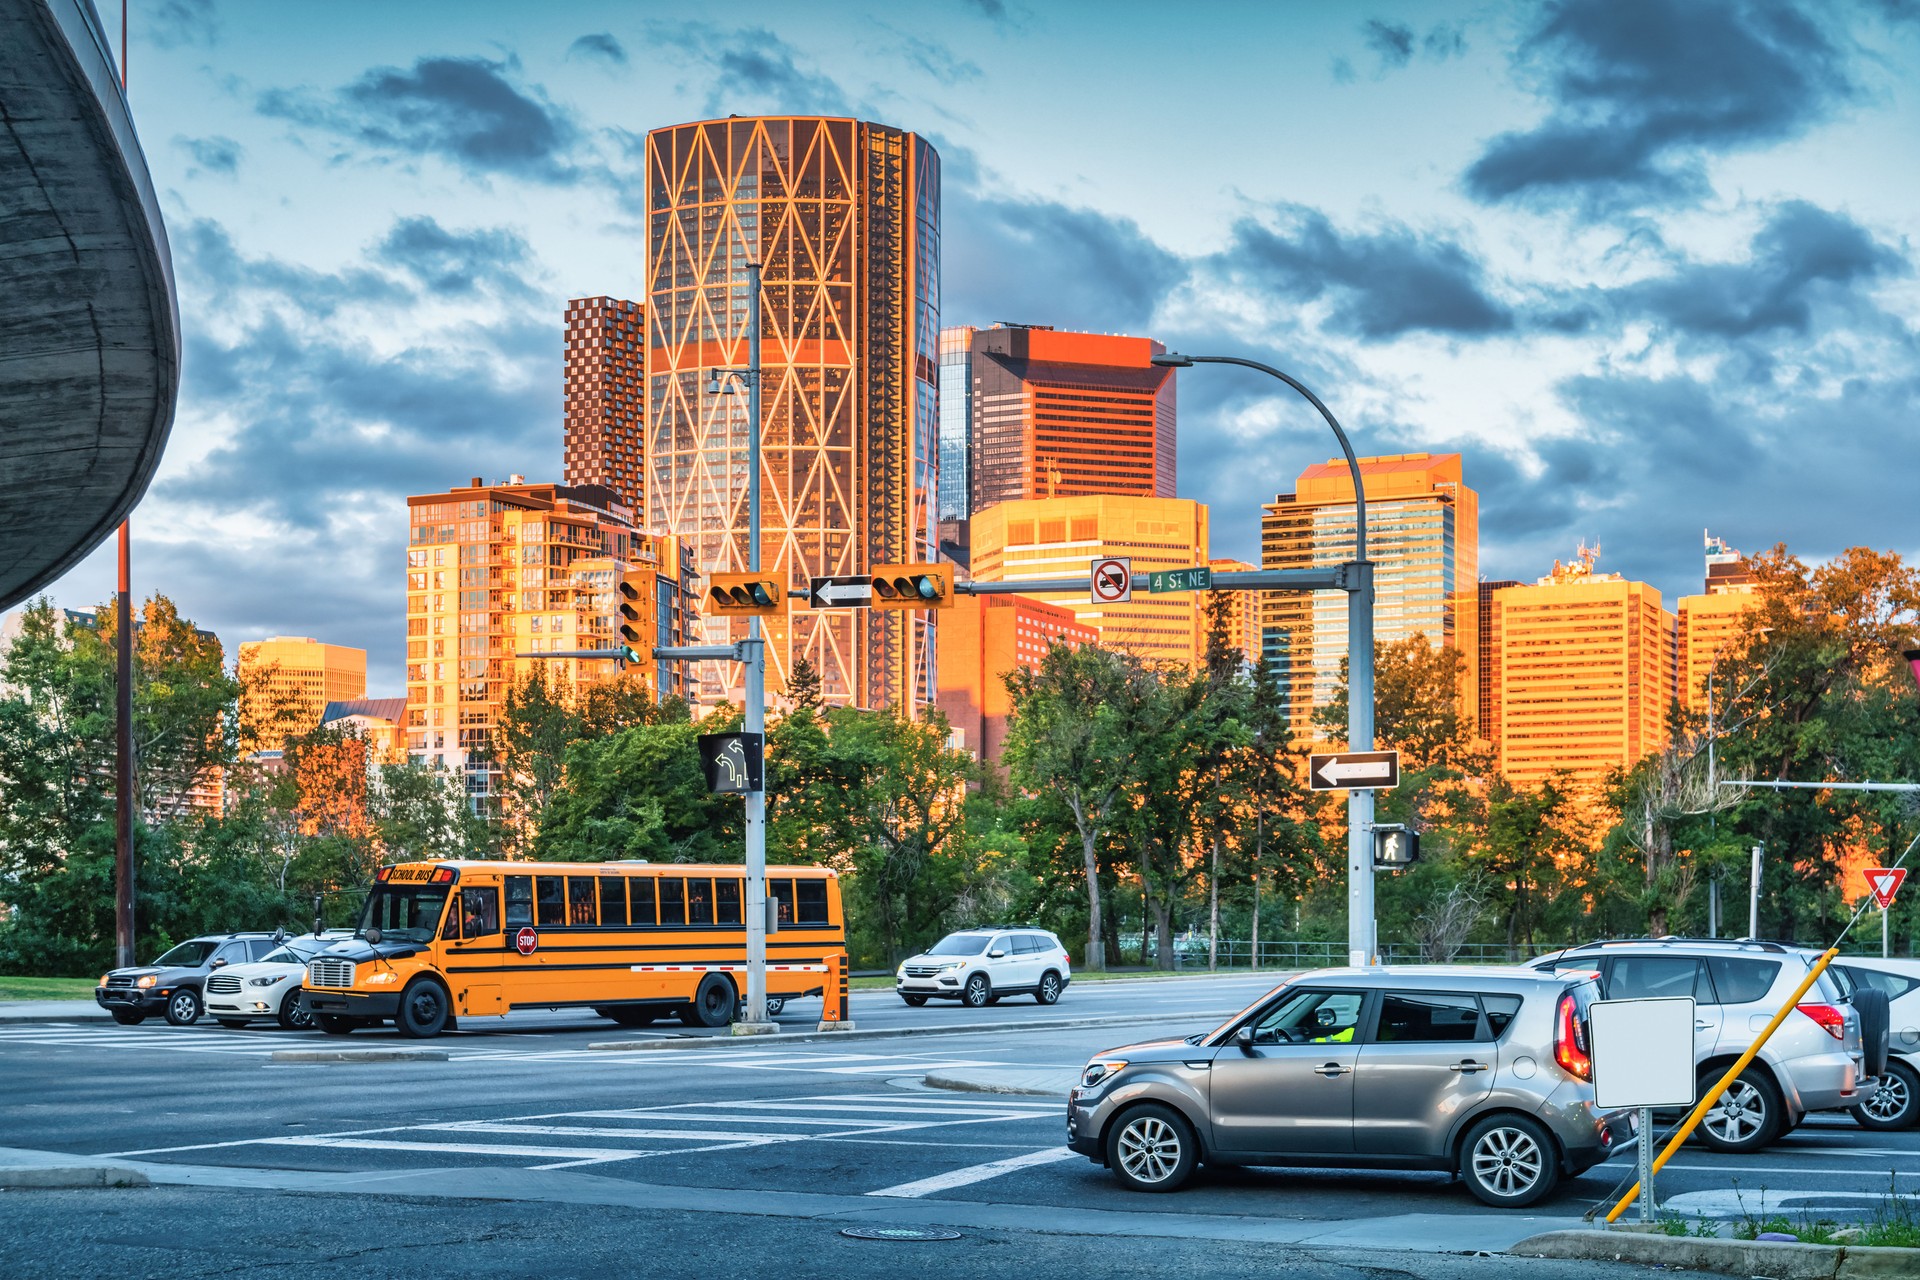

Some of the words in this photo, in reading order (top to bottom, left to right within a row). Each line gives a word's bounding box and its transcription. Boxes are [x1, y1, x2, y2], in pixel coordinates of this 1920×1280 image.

[1153, 574, 1163, 590] 4
[1168, 572, 1184, 589] ST
[1188, 570, 1206, 587] NE
[390, 869, 416, 881] SCHOOL
[415, 869, 432, 881] BUS
[519, 935, 535, 947] STOP
